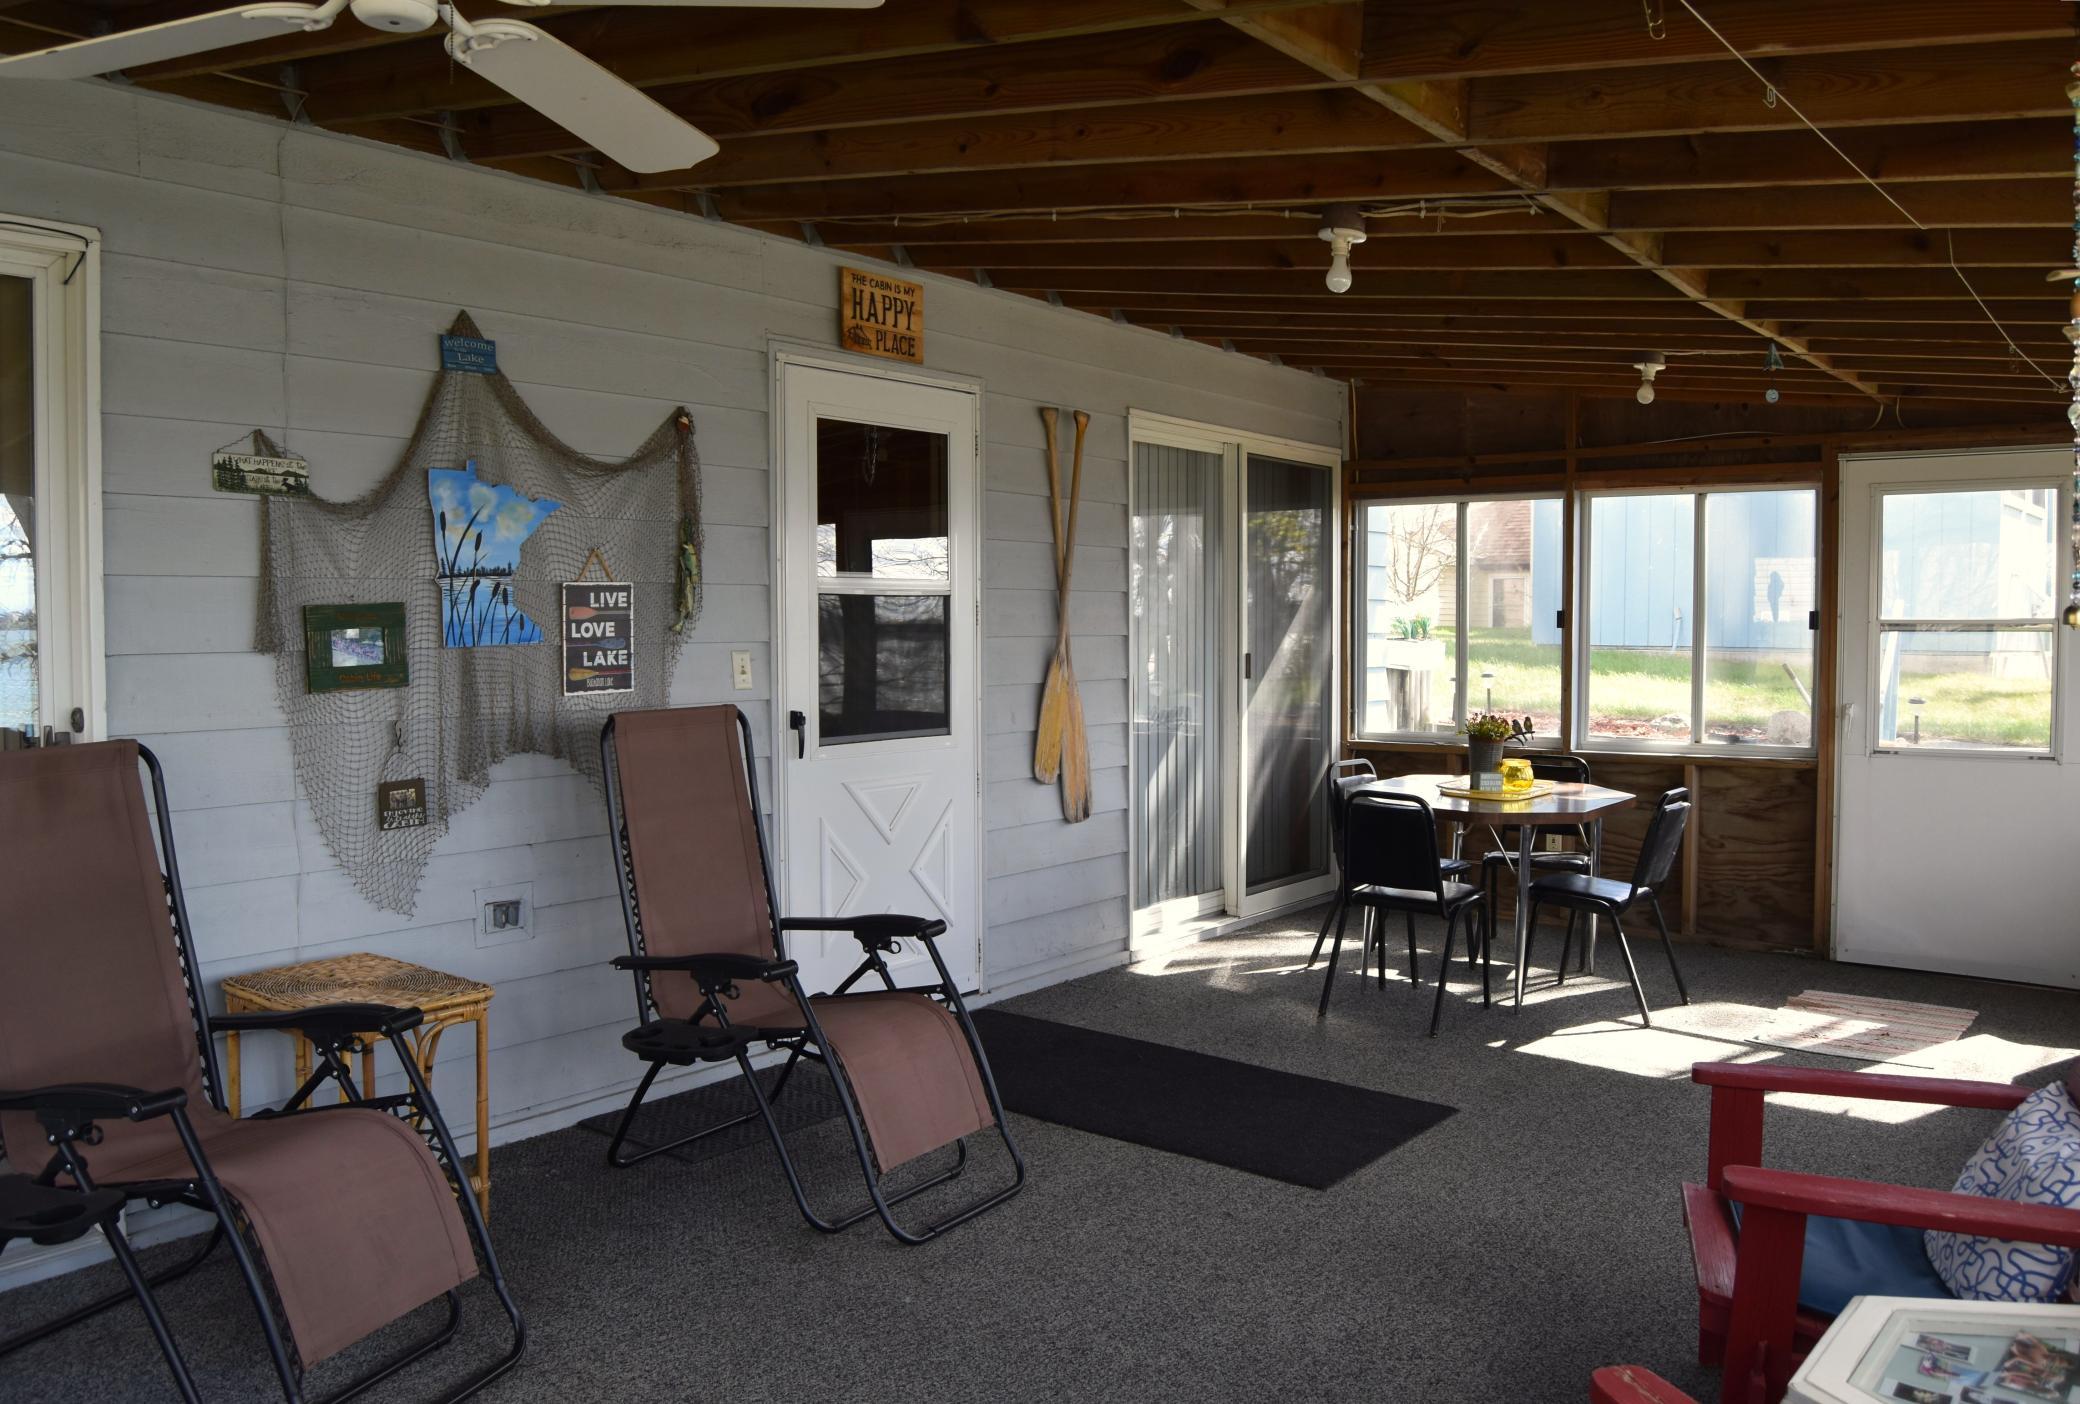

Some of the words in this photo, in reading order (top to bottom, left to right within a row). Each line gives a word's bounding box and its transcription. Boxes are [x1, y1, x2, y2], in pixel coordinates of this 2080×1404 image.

[851, 272, 867, 286] THE
[869, 278, 893, 294] CABIN
[894, 284, 901, 294] IS
[903, 286, 916, 297] MY
[851, 287, 916, 332] HAPPY
[876, 329, 916, 357] PLACE
[457, 352, 485, 364] Lake
[590, 591, 628, 608] LIVE
[571, 621, 616, 638] LOVE
[582, 650, 628, 667] LAKE
